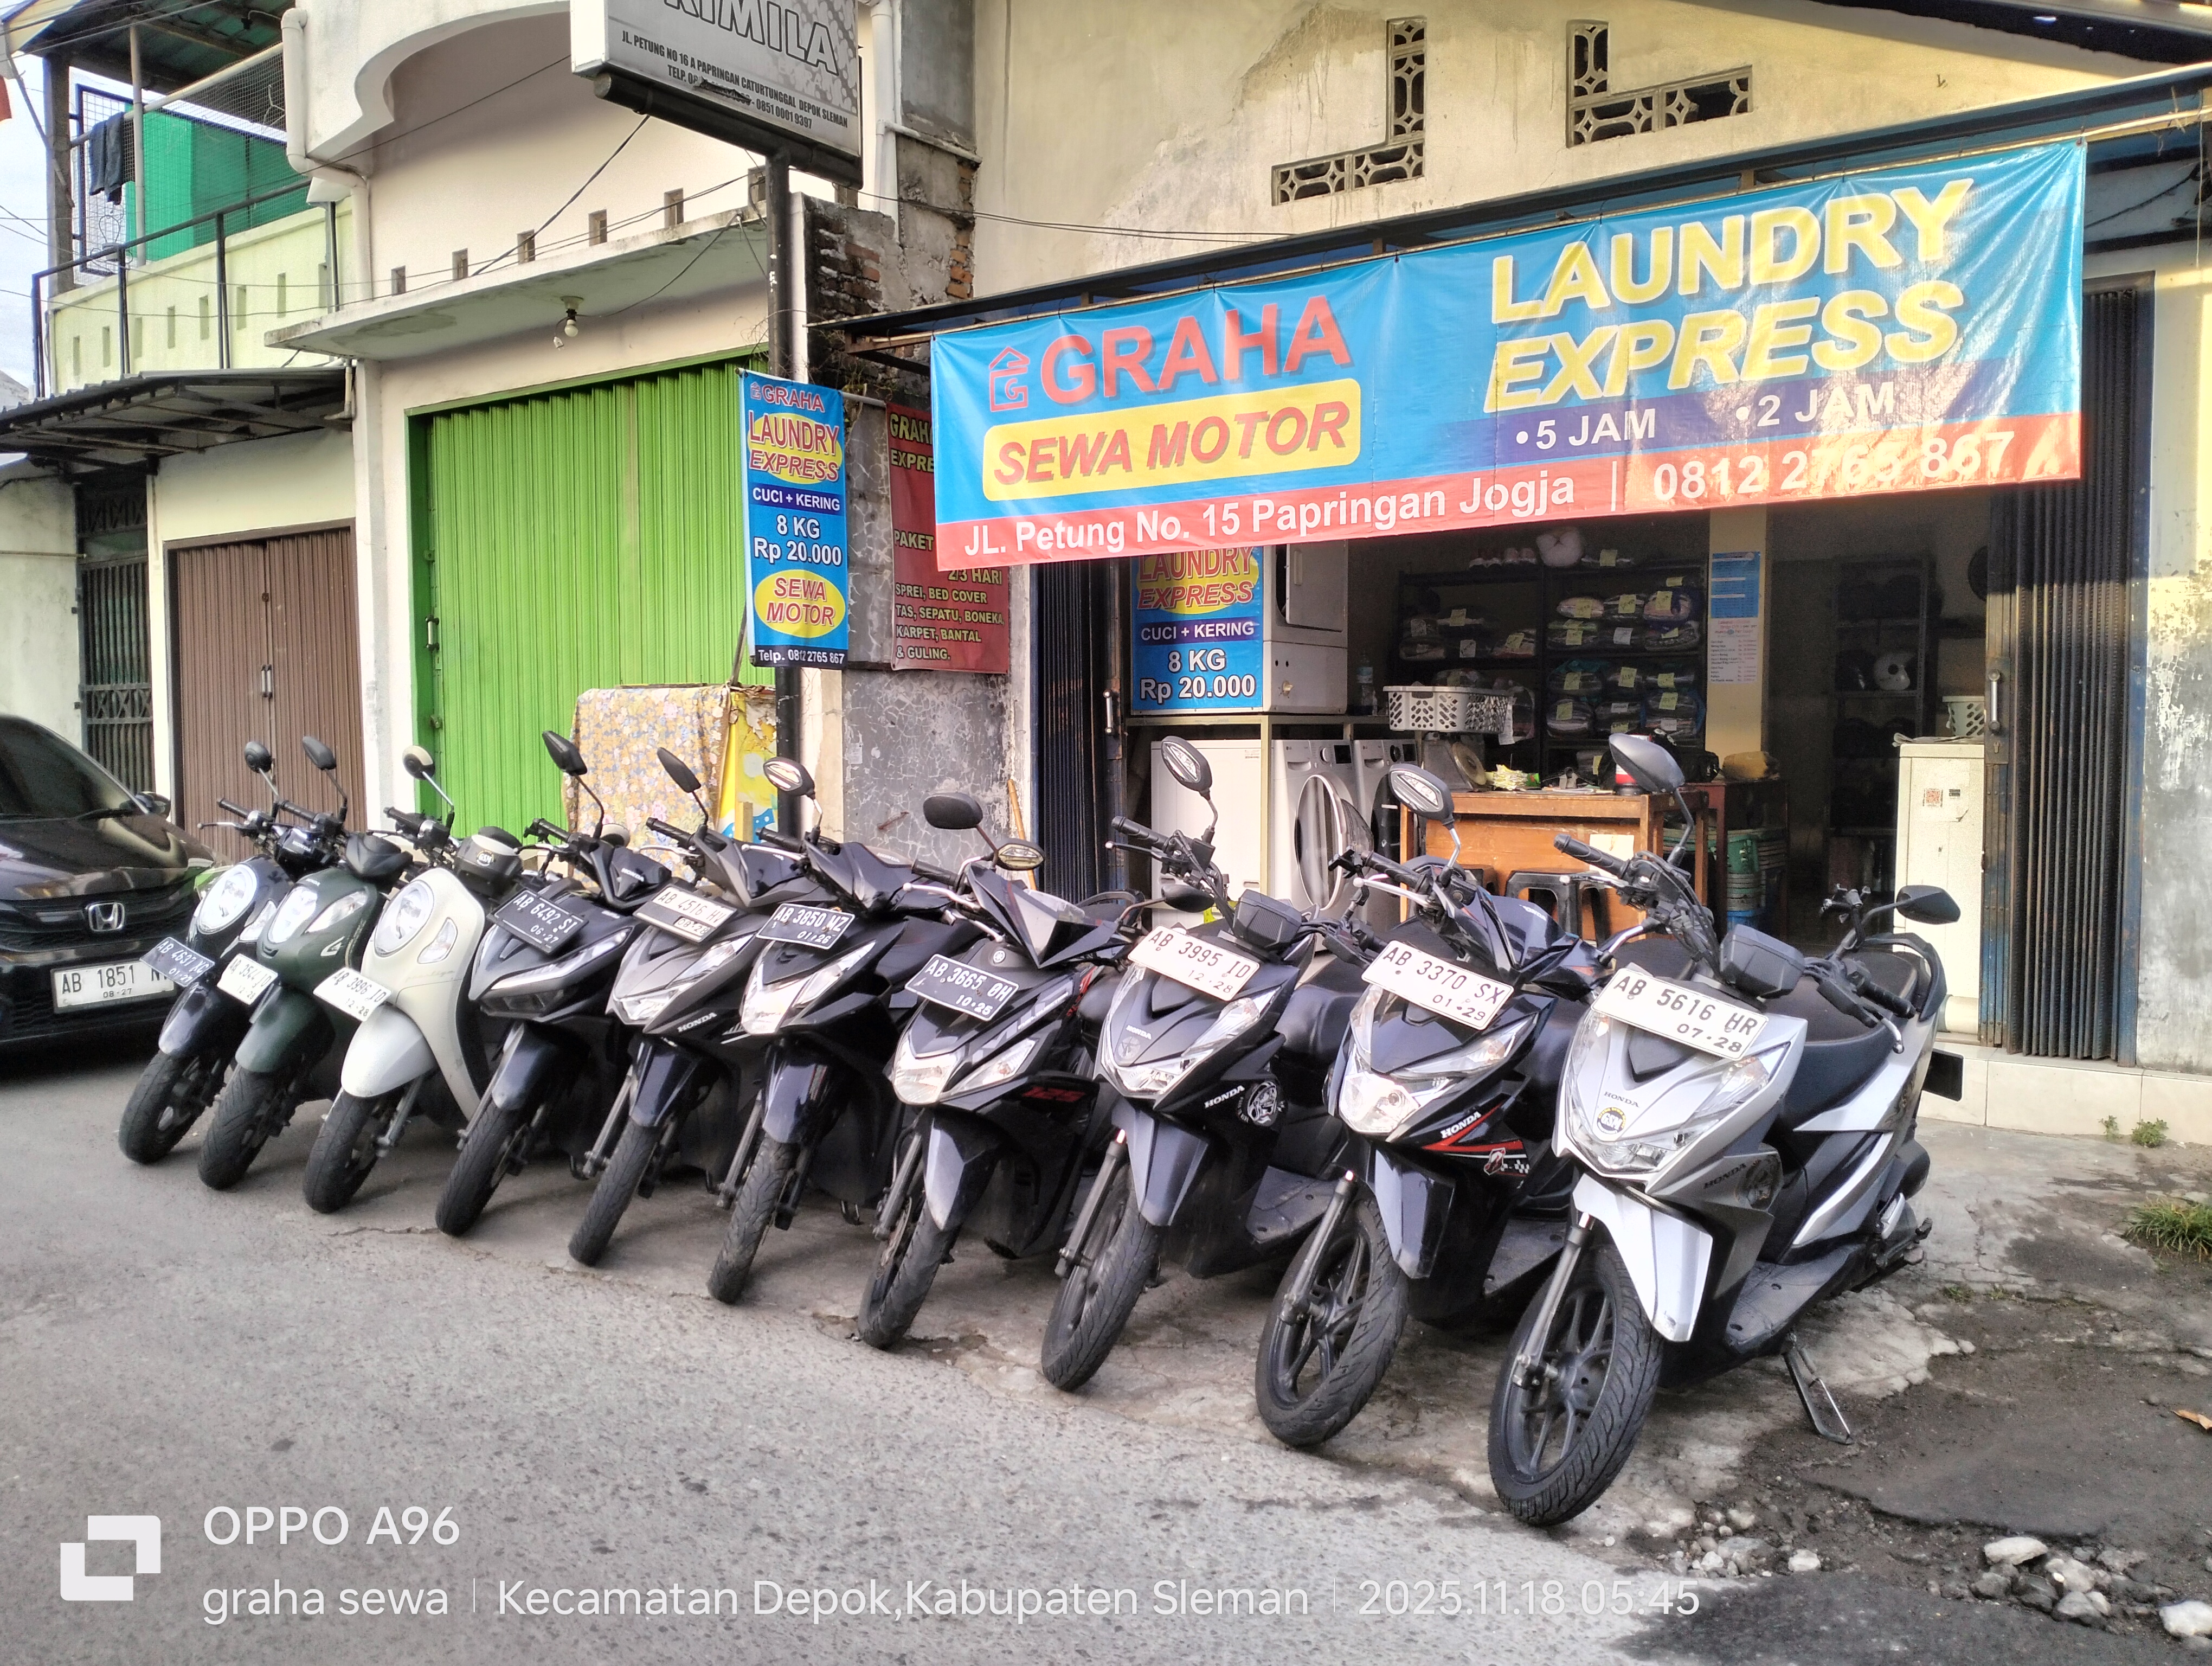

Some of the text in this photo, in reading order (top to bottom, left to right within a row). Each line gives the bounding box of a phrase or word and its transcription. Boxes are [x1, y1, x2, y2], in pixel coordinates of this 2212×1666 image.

[622, 30, 632, 44] JL.
[634, 35, 665, 57] PETUNG
[666, 47, 678, 62] NO
[679, 53, 689, 66] 16
[690, 57, 696, 69] A
[697, 59, 740, 86] PAPRINGAN
[741, 77, 796, 107] CATURTUNGGAL
[799, 99, 821, 117] DEPOK
[822, 108, 848, 128] SLEMAN
[667, 65, 812, 129] TELP. 0851 0001 9397
[1491, 178, 1973, 325] LAUNDRY
[1040, 295, 1354, 405] GRAHA
[1484, 280, 1965, 413] EXPRESS
[762, 385, 825, 413] GRAHA
[1795, 382, 1894, 422] JAM
[749, 409, 839, 456] LAUNDRY
[890, 413, 932, 445] GRAH
[1570, 408, 1656, 448] JAM
[994, 401, 1349, 485] SEWA MOTOR
[749, 450, 840, 482] EXPRESS
[753, 487, 782, 504] CUCI
[796, 493, 840, 511] KERING
[964, 526, 1005, 556] JL.
[1016, 518, 1126, 553] Petung
[1137, 510, 1190, 542] No.
[1203, 502, 1240, 536] 15
[1252, 490, 1445, 536] Papringan
[1459, 470, 1574, 516] Jogja
[1652, 454, 1767, 502] 0812
[1920, 431, 2015, 478] 867
[776, 514, 821, 539] 8 KG
[894, 529, 934, 551] PAKET
[754, 538, 842, 566] Rp 20.000
[1138, 546, 1253, 581] LAUNDRY
[774, 577, 827, 601] SEWA
[972, 568, 1002, 585] HARI
[895, 584, 987, 604] SPREI, BED COVER
[1137, 581, 1255, 609] EXPRESS
[766, 602, 835, 626] MOTOR
[896, 605, 1005, 625] TAS, SEPATU, BONEKA,
[896, 625, 982, 642] KARPET, BANTAL
[1141, 626, 1176, 641] CUCI
[1194, 621, 1255, 638] KERING
[758, 649, 785, 663] Telp.
[807, 651, 828, 663] 2765
[829, 652, 845, 664] 867
[897, 646, 950, 660] & GULING.
[1168, 649, 1226, 672] 8 KG
[1140, 675, 1256, 704] Rp 20.000
[513, 894, 535, 908] AB
[530, 904, 561, 925] 6492
[658, 891, 727, 924] AB 4516 HV
[774, 907, 850, 932] AB 3850 MZ
[157, 940, 173, 953] AB
[171, 950, 196, 966] 4637
[1148, 931, 1251, 978] AB 3995 ID
[62, 972, 82, 995] AB
[97, 965, 135, 989] 1851
[925, 959, 949, 977] AB
[947, 967, 987, 990] 3665
[1382, 946, 1506, 1005] AB 3370 SX
[1613, 975, 1758, 1036] AB 5616 HR
[677, 1013, 717, 1033] HONDA
[1126, 1024, 1152, 1040] HONDA
[1204, 1085, 1245, 1108] HONDA
[1603, 1091, 1639, 1108] HONDA
[1440, 1111, 1482, 1139] HONDA
[1703, 1163, 1747, 1190] HONDA
